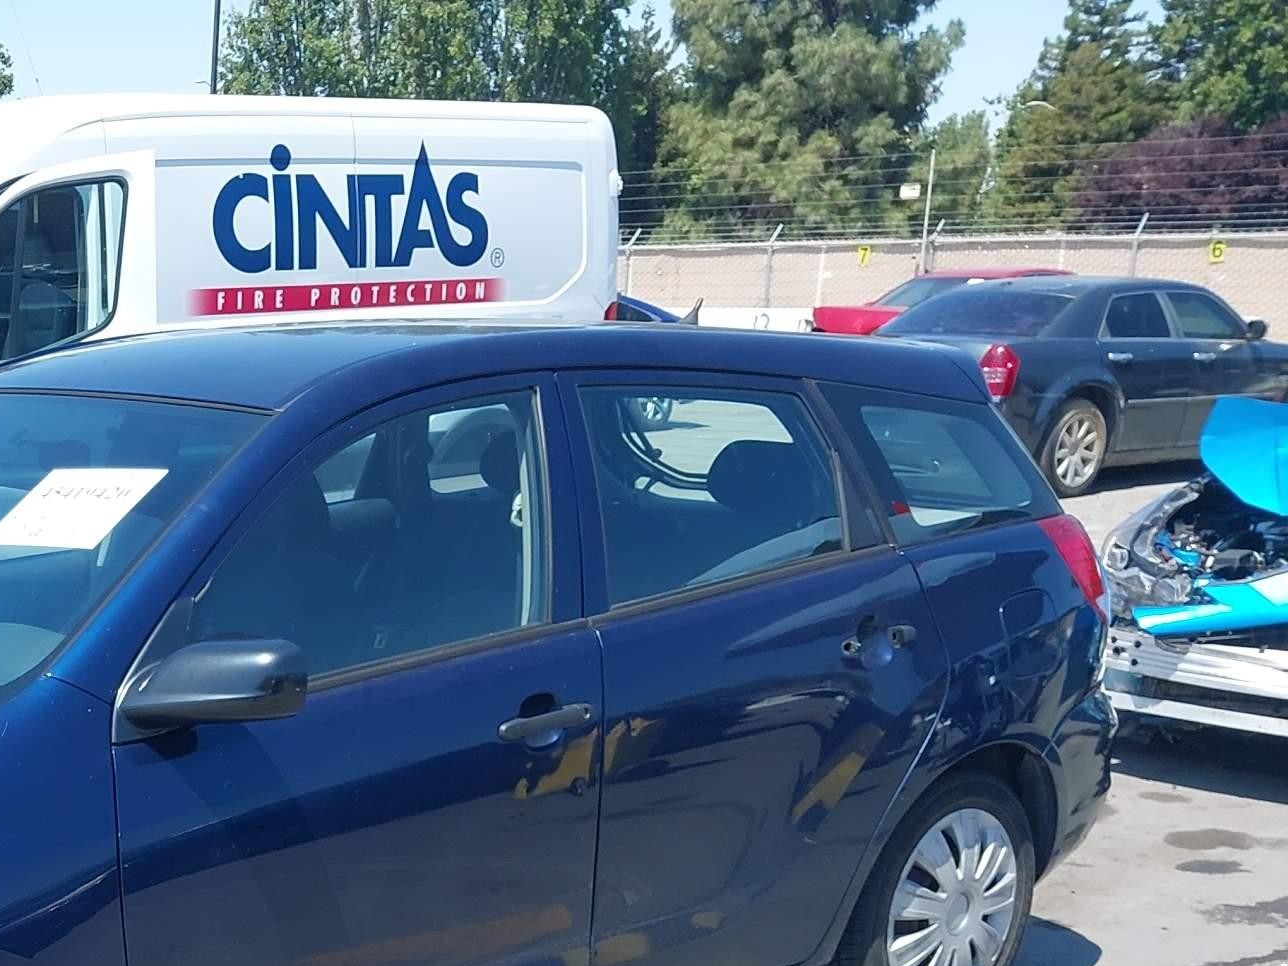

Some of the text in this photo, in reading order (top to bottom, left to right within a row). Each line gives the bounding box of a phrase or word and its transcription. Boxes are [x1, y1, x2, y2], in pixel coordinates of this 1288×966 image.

[860, 247, 868, 263] 7
[1212, 240, 1223, 258] 6
[216, 281, 487, 311] FIRE PROTECTION
